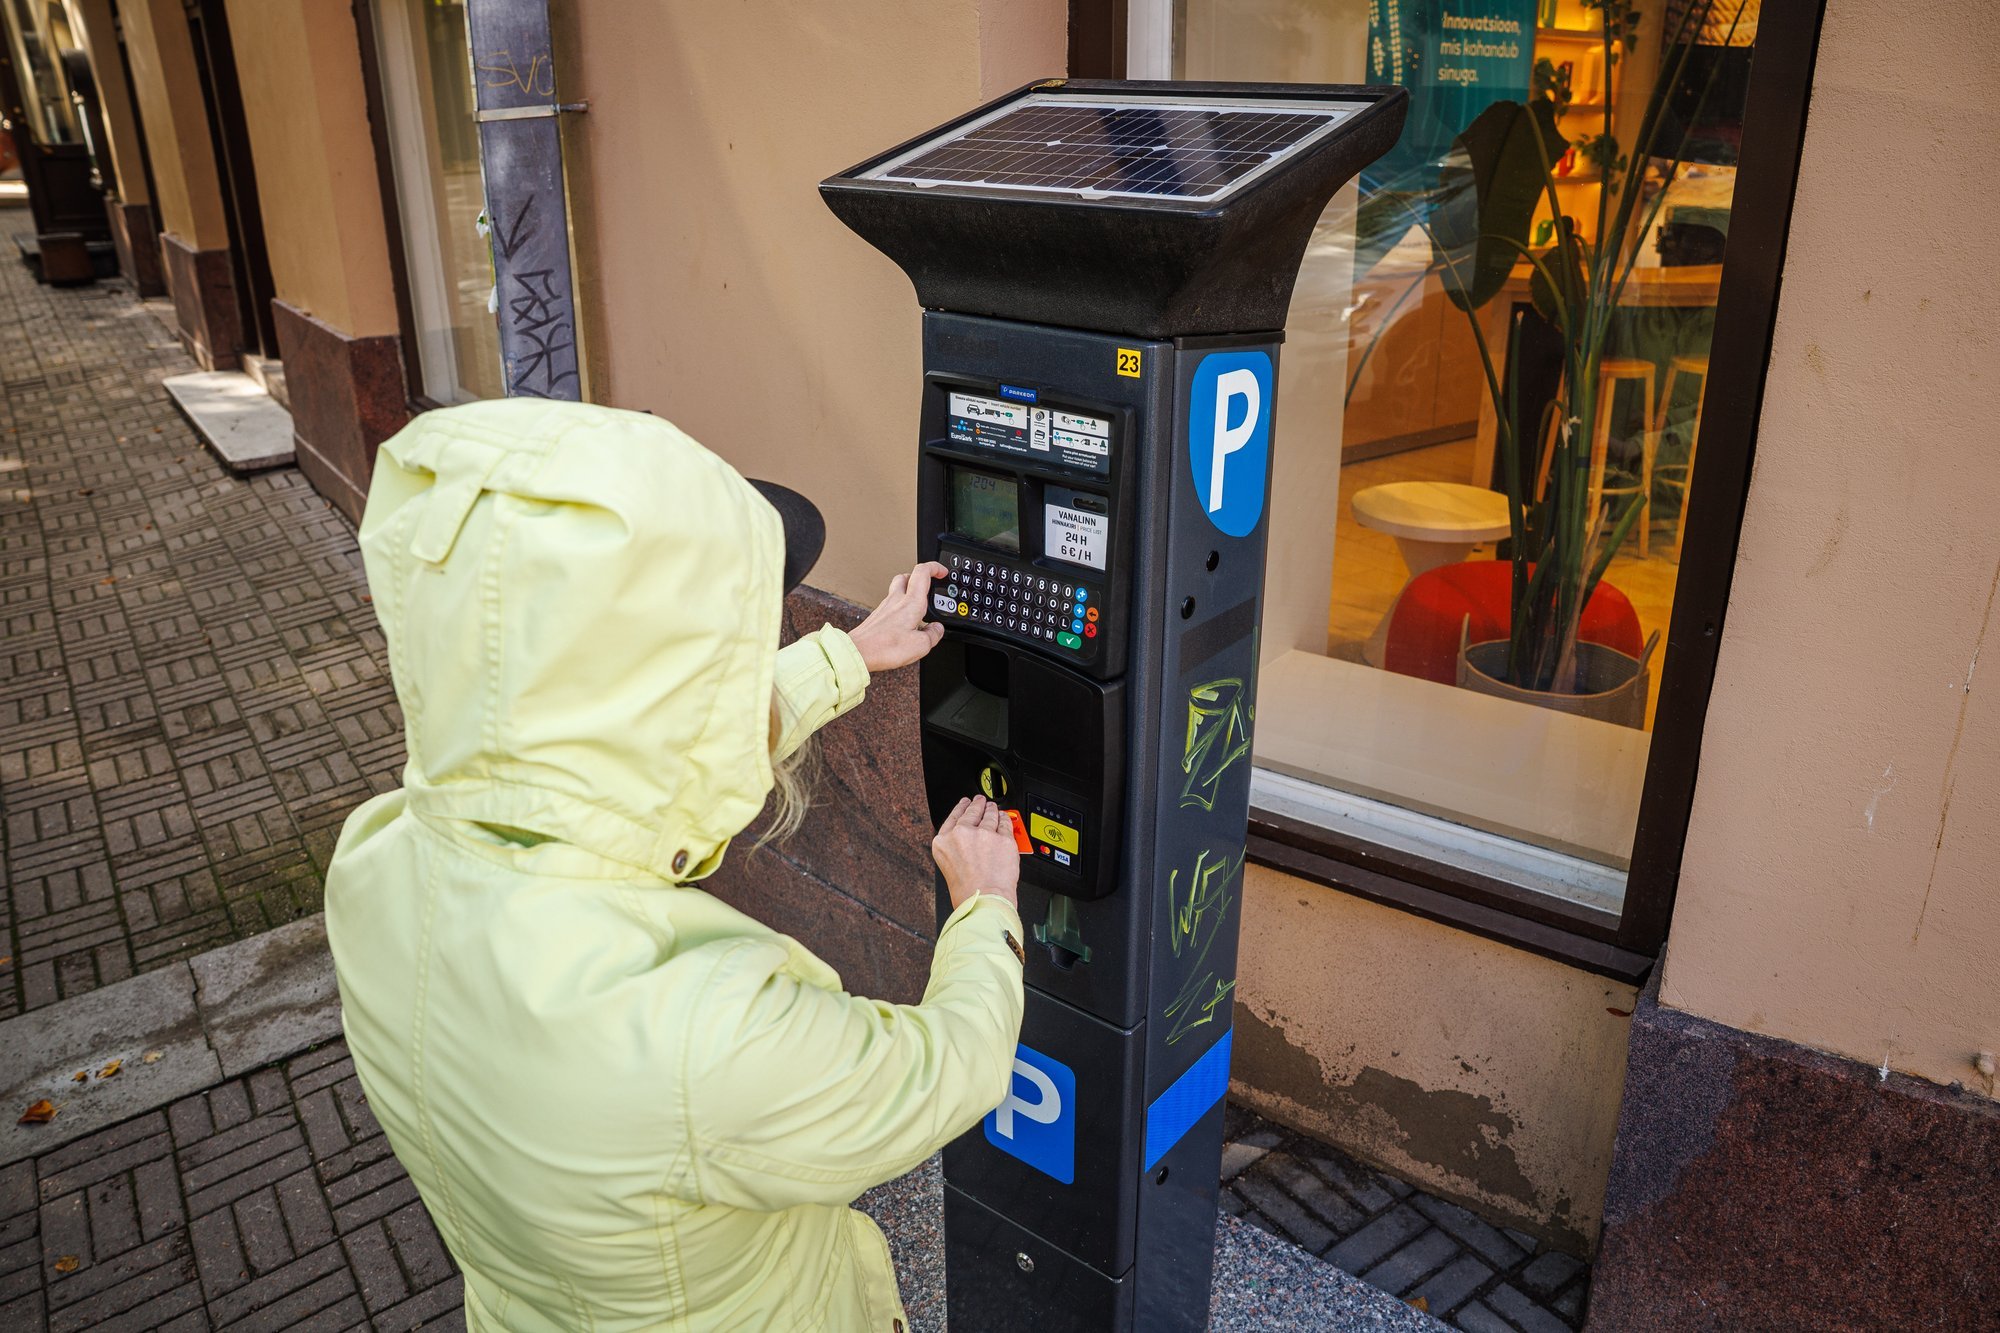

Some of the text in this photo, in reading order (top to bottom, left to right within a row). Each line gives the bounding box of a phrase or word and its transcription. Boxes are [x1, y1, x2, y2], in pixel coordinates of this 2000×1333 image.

[1442, 11, 1521, 35] Innovatsioon,
[1440, 38, 1519, 58] mis kohandub
[1438, 64, 1479, 86] sinuga.
[1119, 353, 1139, 373] 23
[1209, 368, 1260, 513] P
[1052, 519, 1076, 530] HINNAKIRI
[1058, 510, 1096, 526] VANALINN
[1065, 532, 1087, 546] 24 H
[1061, 545, 1067, 555] 6
[1069, 547, 1076, 557] €
[1085, 551, 1091, 561] H
[953, 557, 1071, 597] 1 2 3 4 5 6 7 8 9 0
[951, 572, 957, 580] Q
[963, 575, 970, 583] W
[975, 578, 981, 587] E
[987, 582, 993, 590] R
[1000, 585, 1005, 593] T
[1012, 589, 1018, 597] Y
[1024, 592, 1030, 600] U
[1050, 599, 1056, 608] O
[1063, 603, 1069, 611] P
[961, 590, 967, 598] A
[974, 594, 979, 602] S
[986, 597, 991, 605] D
[998, 600, 1003, 608] F
[1010, 604, 1016, 612] G
[1023, 607, 1029, 616] H
[1048, 615, 1054, 623] K
[1062, 618, 1067, 627] L
[972, 608, 1053, 639] Z X C V B N M
[1056, 853, 1069, 862] VISA
[996, 1057, 1061, 1140] P
